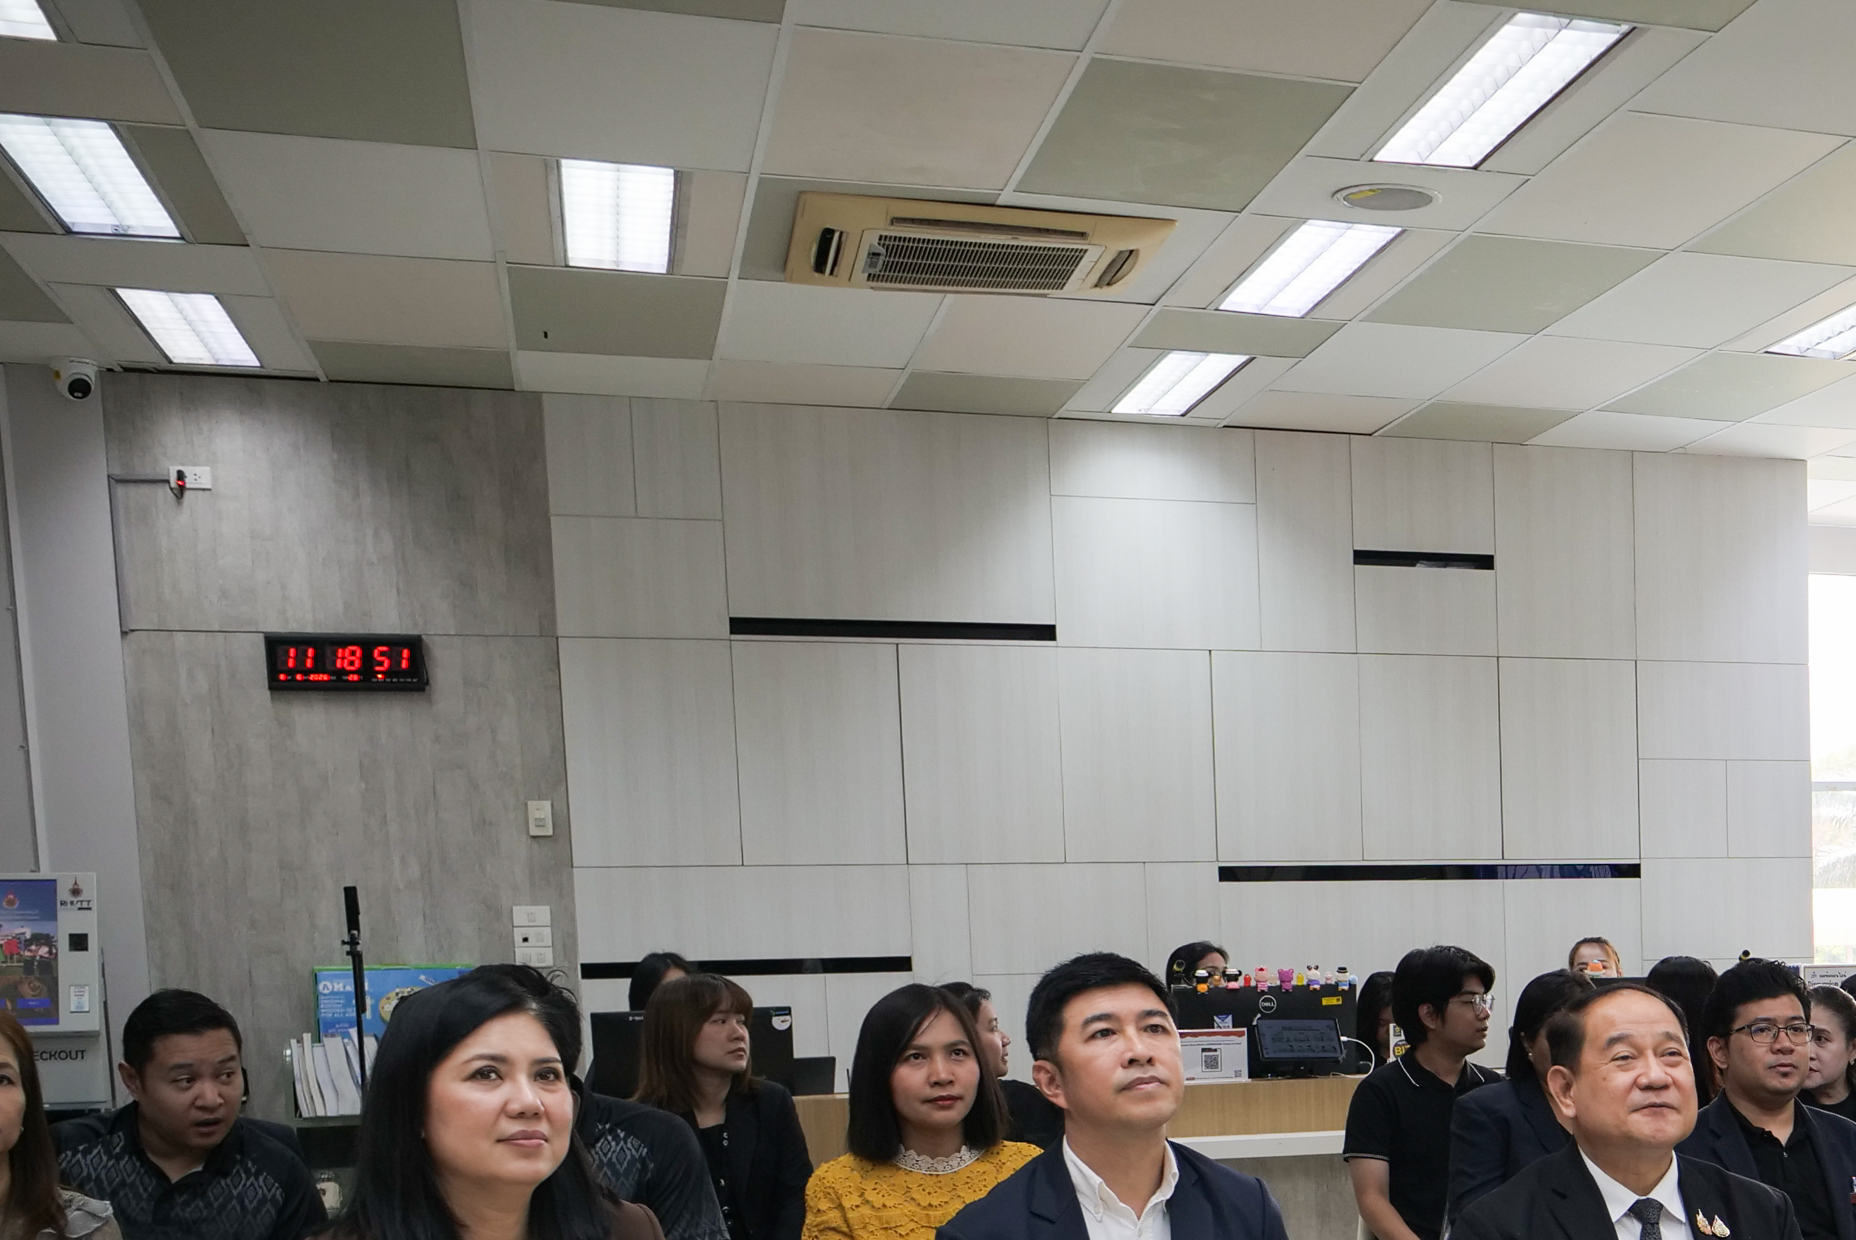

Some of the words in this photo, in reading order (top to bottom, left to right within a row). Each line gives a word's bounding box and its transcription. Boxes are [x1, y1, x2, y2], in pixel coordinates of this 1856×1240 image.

[336, 645, 363, 671] 18
[373, 646, 410, 671] 51
[33, 1049, 86, 1061] ECKOUT
